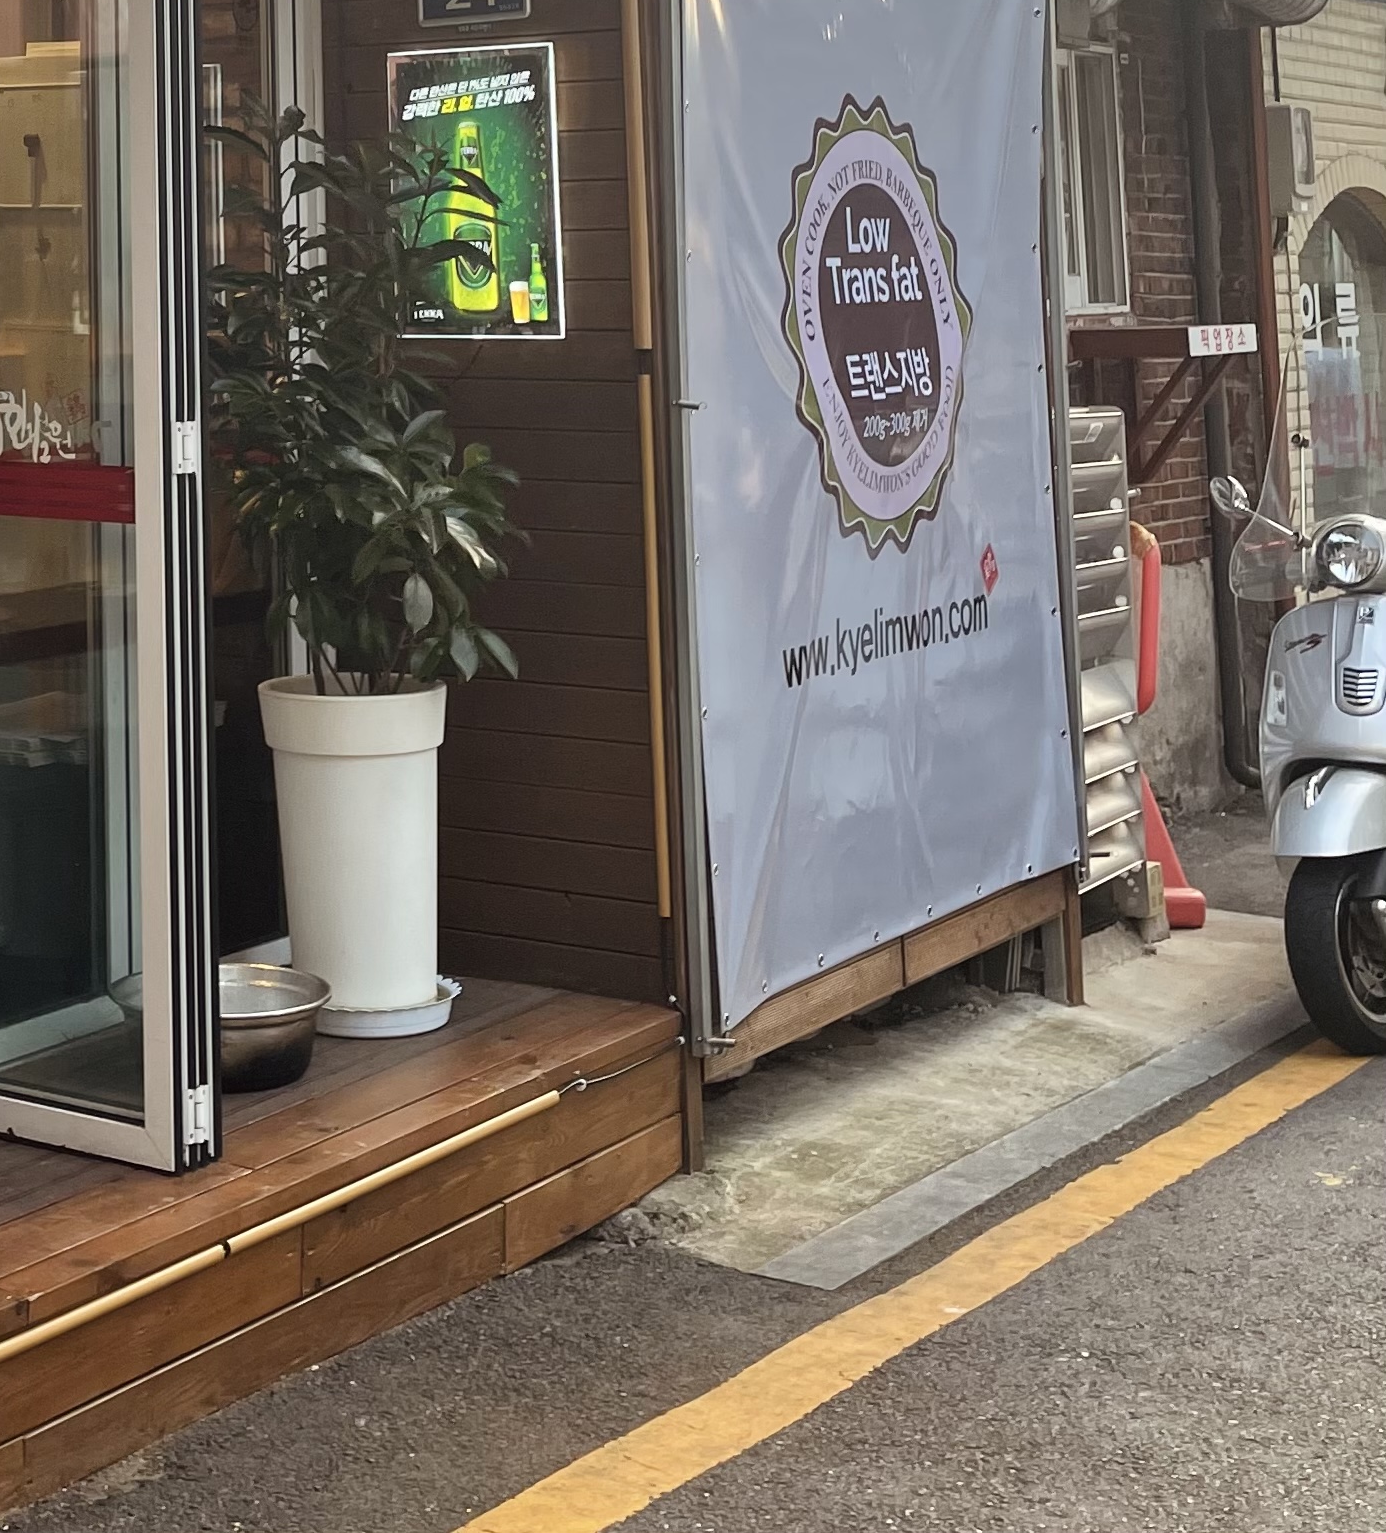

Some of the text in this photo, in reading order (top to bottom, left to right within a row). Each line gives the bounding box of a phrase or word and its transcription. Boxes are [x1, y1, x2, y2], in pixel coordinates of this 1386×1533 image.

[503, 84, 535, 105] 100%
[802, 260, 816, 342] OVEN
[826, 166, 850, 202] NOT
[929, 257, 954, 331] ONLY
[845, 206, 891, 254] Low
[825, 253, 923, 305] Trans fat
[1200, 326, 1247, 354] 픽업장소
[845, 346, 933, 401] 트랜스지방
[822, 377, 852, 448] ENJOY
[782, 590, 990, 689] www.kyelimwon.com
